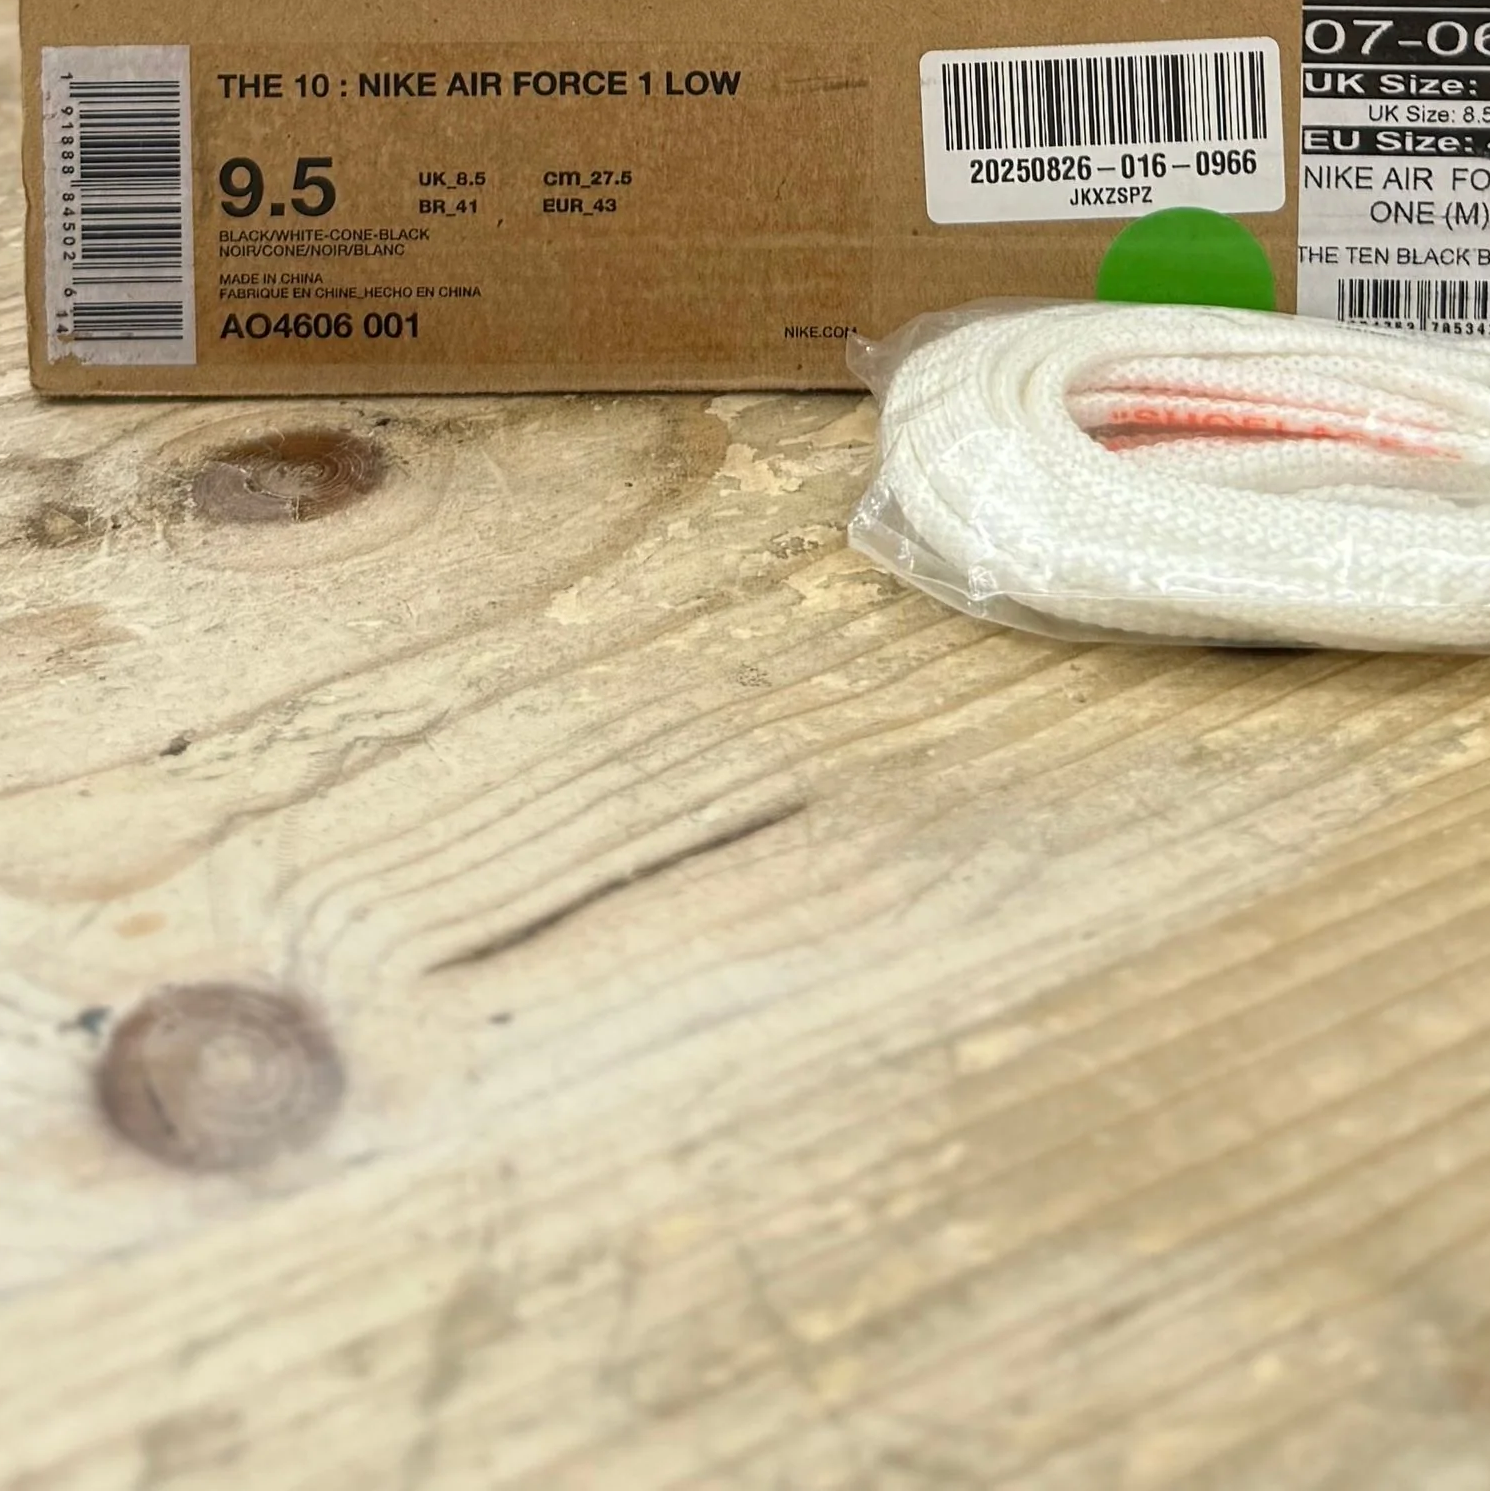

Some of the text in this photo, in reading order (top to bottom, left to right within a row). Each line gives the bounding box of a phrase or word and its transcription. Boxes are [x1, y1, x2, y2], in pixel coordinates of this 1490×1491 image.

[217, 74, 283, 98] THE
[295, 74, 330, 98] 10
[359, 73, 437, 97] NIKE
[446, 72, 503, 96] AIR
[513, 71, 628, 96] FORCE
[638, 71, 652, 95] 1
[665, 71, 742, 95] LOW
[1304, 72, 1365, 94] UK
[1379, 72, 1478, 95] Size:
[1368, 105, 1400, 122] UK
[1405, 105, 1456, 123] Size:
[1303, 129, 1361, 151] EU
[1375, 130, 1473, 153] Size:
[219, 156, 337, 217] 9.5
[418, 171, 487, 189] UK_8.5
[1304, 166, 1373, 190] NIKE
[1381, 167, 1435, 191] AIR
[1069, 186, 1154, 206] JKXZSPZ
[418, 199, 479, 217] BR_41
[543, 198, 617, 216] EUR_43
[1370, 200, 1490, 231] ONE (M)
[219, 228, 430, 242] BLACK/WHITE-CONE-BLACK
[219, 244, 405, 257] NOIR/CONE/NOIR/BLANC
[1298, 246, 1340, 264] THE
[1345, 247, 1390, 265] TEN
[1396, 247, 1472, 267] BLACK
[219, 273, 324, 285] MADE IN CHINA
[219, 287, 289, 299] FABRIQUE
[292, 287, 311, 299] EN
[416, 286, 435, 298] EN
[438, 286, 482, 298] CHINA
[363, 312, 419, 338] 001
